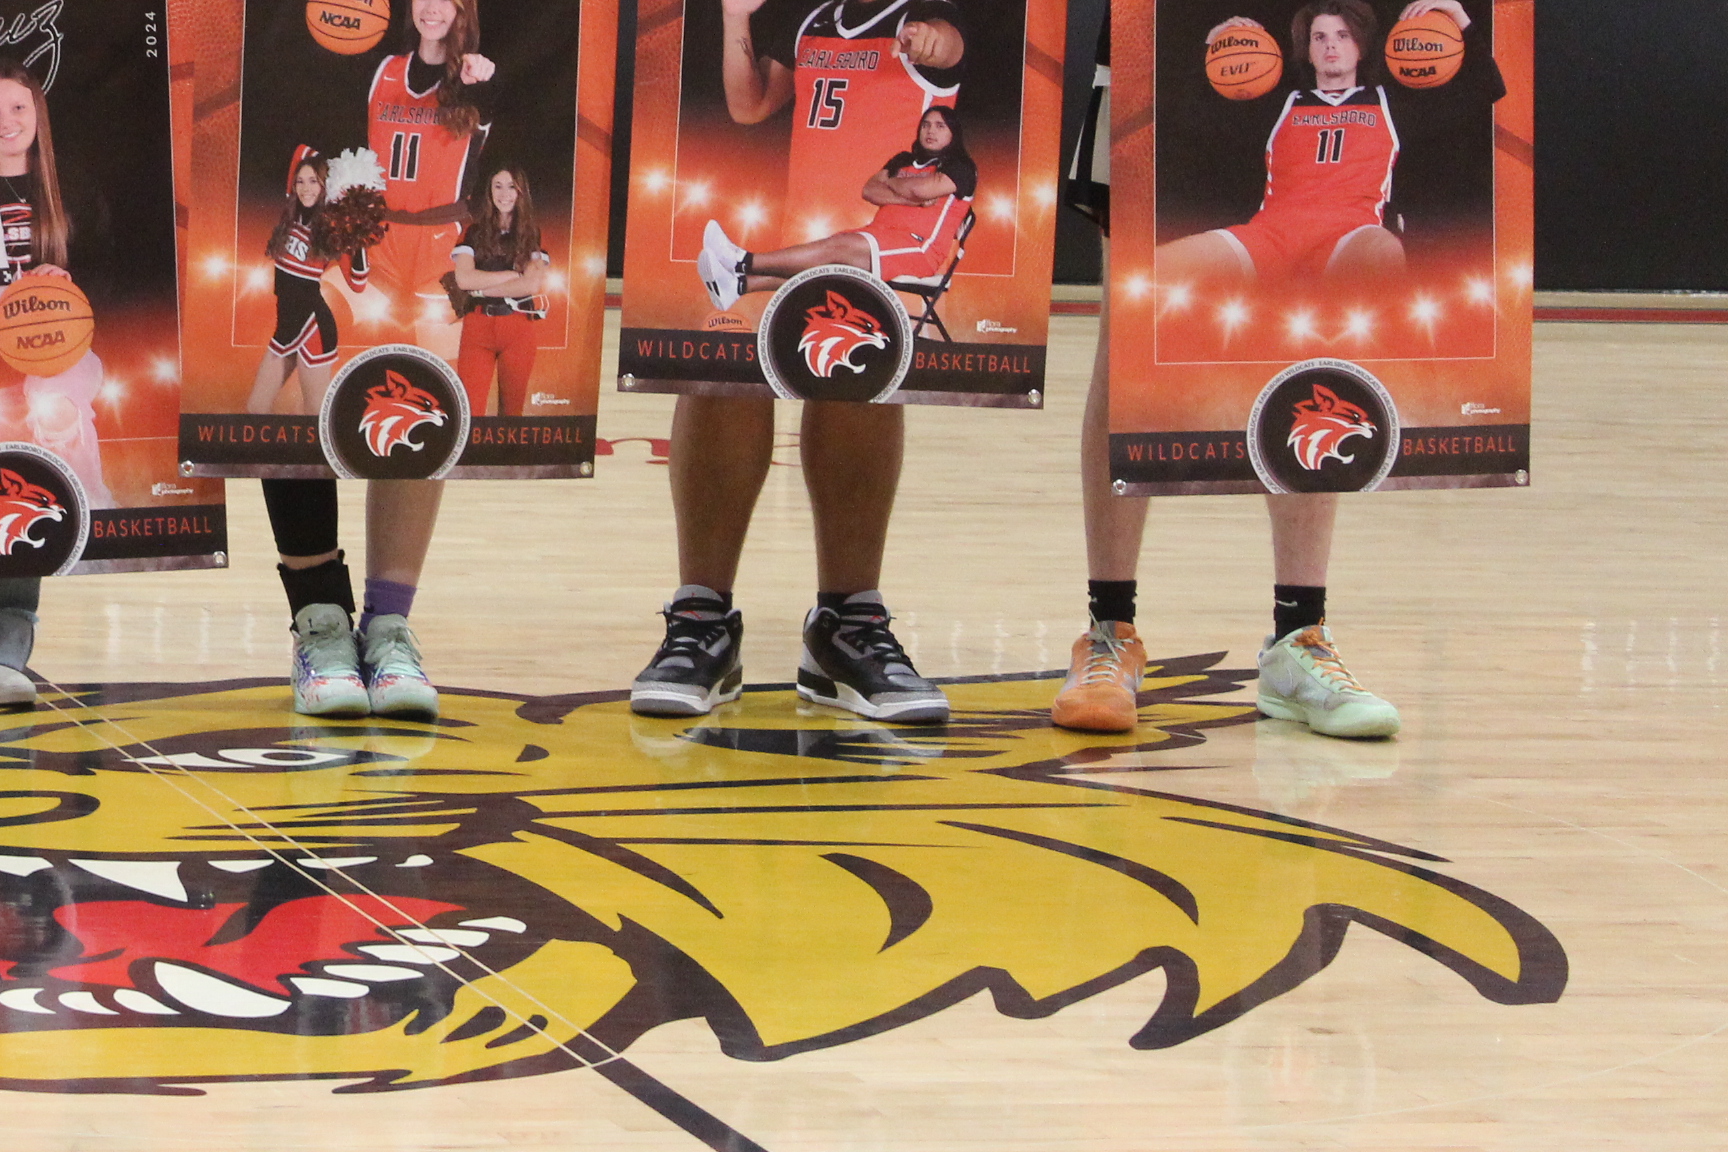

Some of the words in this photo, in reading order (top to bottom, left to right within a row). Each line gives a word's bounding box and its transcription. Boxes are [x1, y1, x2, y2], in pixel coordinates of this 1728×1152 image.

[319, 10, 362, 31] NCAA
[146, 10, 157, 58] 2024
[1211, 36, 1259, 54] Wilson
[1393, 38, 1444, 54] Wilson
[1399, 65, 1437, 78] NCAA
[807, 77, 849, 130] 15
[1292, 110, 1377, 128] EARLSBORO
[389, 131, 422, 182] 11
[1315, 128, 1345, 164] 11
[2, 296, 71, 320] Wilson
[16, 330, 66, 350] NCAA
[637, 340, 755, 361] WILDCATS
[915, 352, 1031, 374] BASKETBALL
[197, 424, 316, 445] WILDCATS
[472, 425, 583, 445] BASKETBALL
[1127, 441, 1245, 462] WILDCATS
[1403, 436, 1517, 457] BASKETBALL
[94, 516, 212, 540] BASKETBALL
